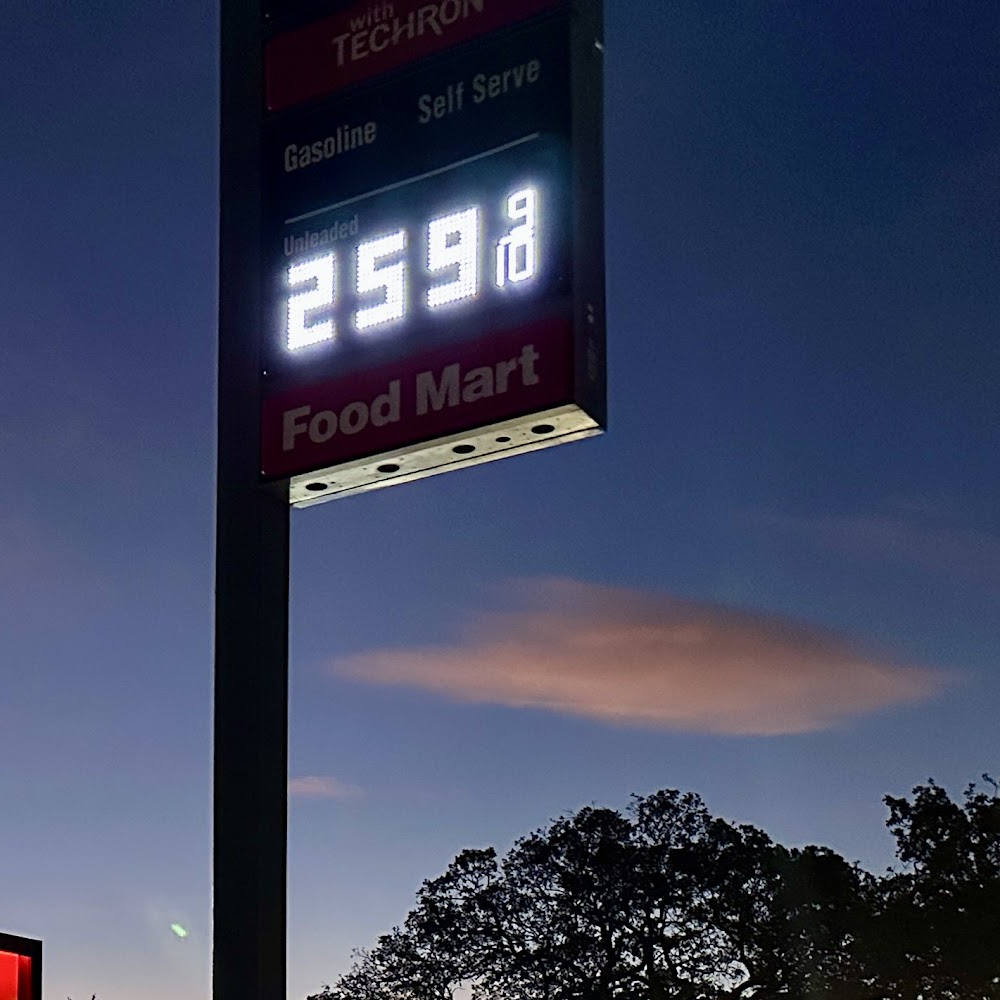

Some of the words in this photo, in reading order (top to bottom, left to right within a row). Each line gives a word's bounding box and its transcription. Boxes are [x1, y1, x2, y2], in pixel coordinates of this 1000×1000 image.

[332, 0, 484, 67] TECHRON
[350, 0, 394, 32] with
[417, 81, 465, 124] Self
[472, 58, 541, 104] Serve
[284, 121, 377, 173] Gasoline
[284, 214, 360, 257] Unleaded
[286, 206, 479, 351] 259
[282, 379, 401, 451] Food
[415, 343, 540, 416] Mart
